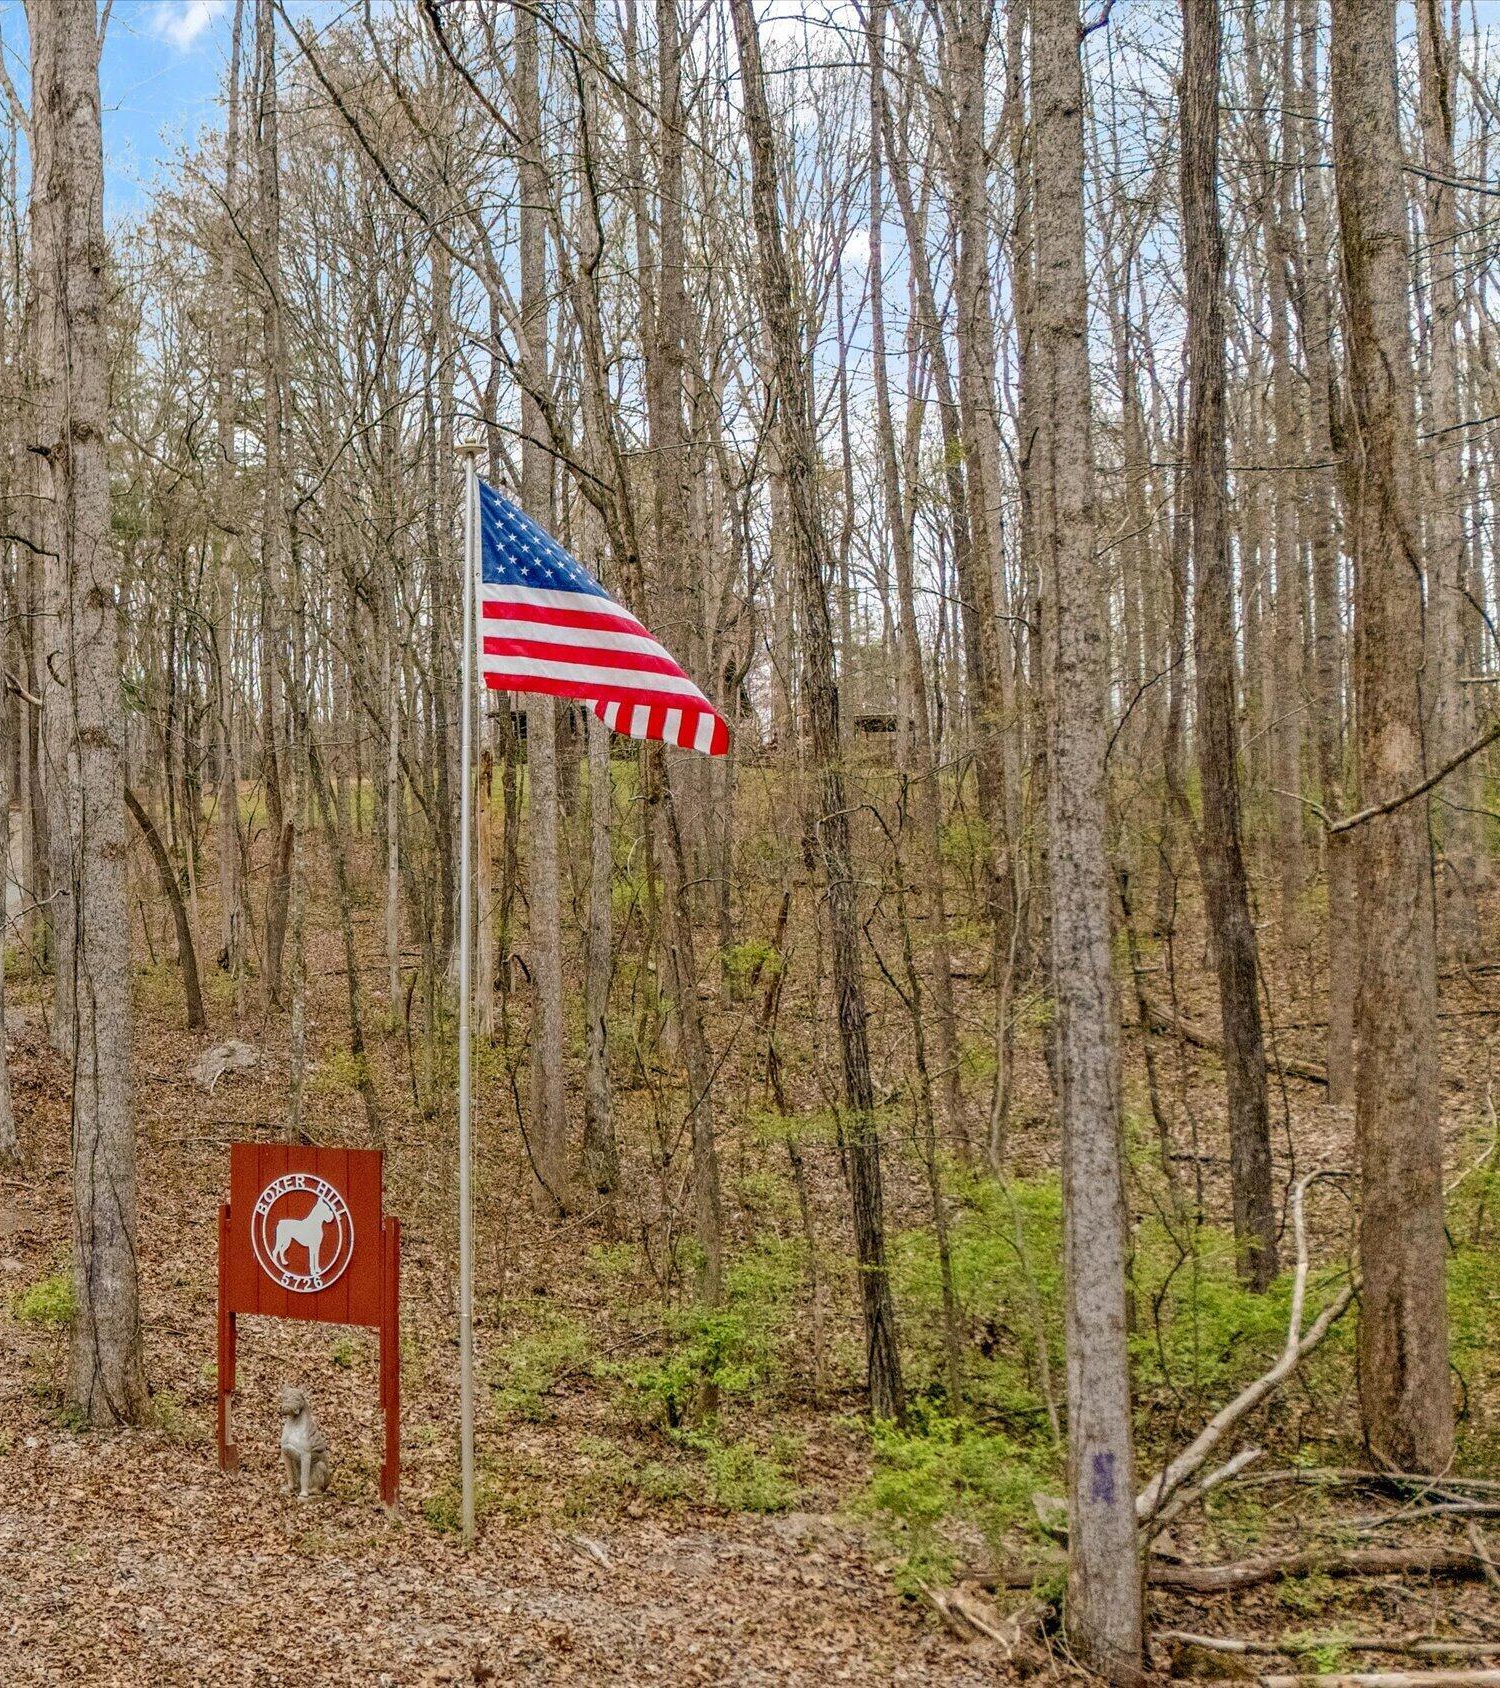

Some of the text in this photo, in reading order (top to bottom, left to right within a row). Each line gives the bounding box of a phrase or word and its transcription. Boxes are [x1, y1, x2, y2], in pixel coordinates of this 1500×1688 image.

[256, 1175, 348, 1220] BOXER HILL
[281, 1273, 323, 1291] 5726
